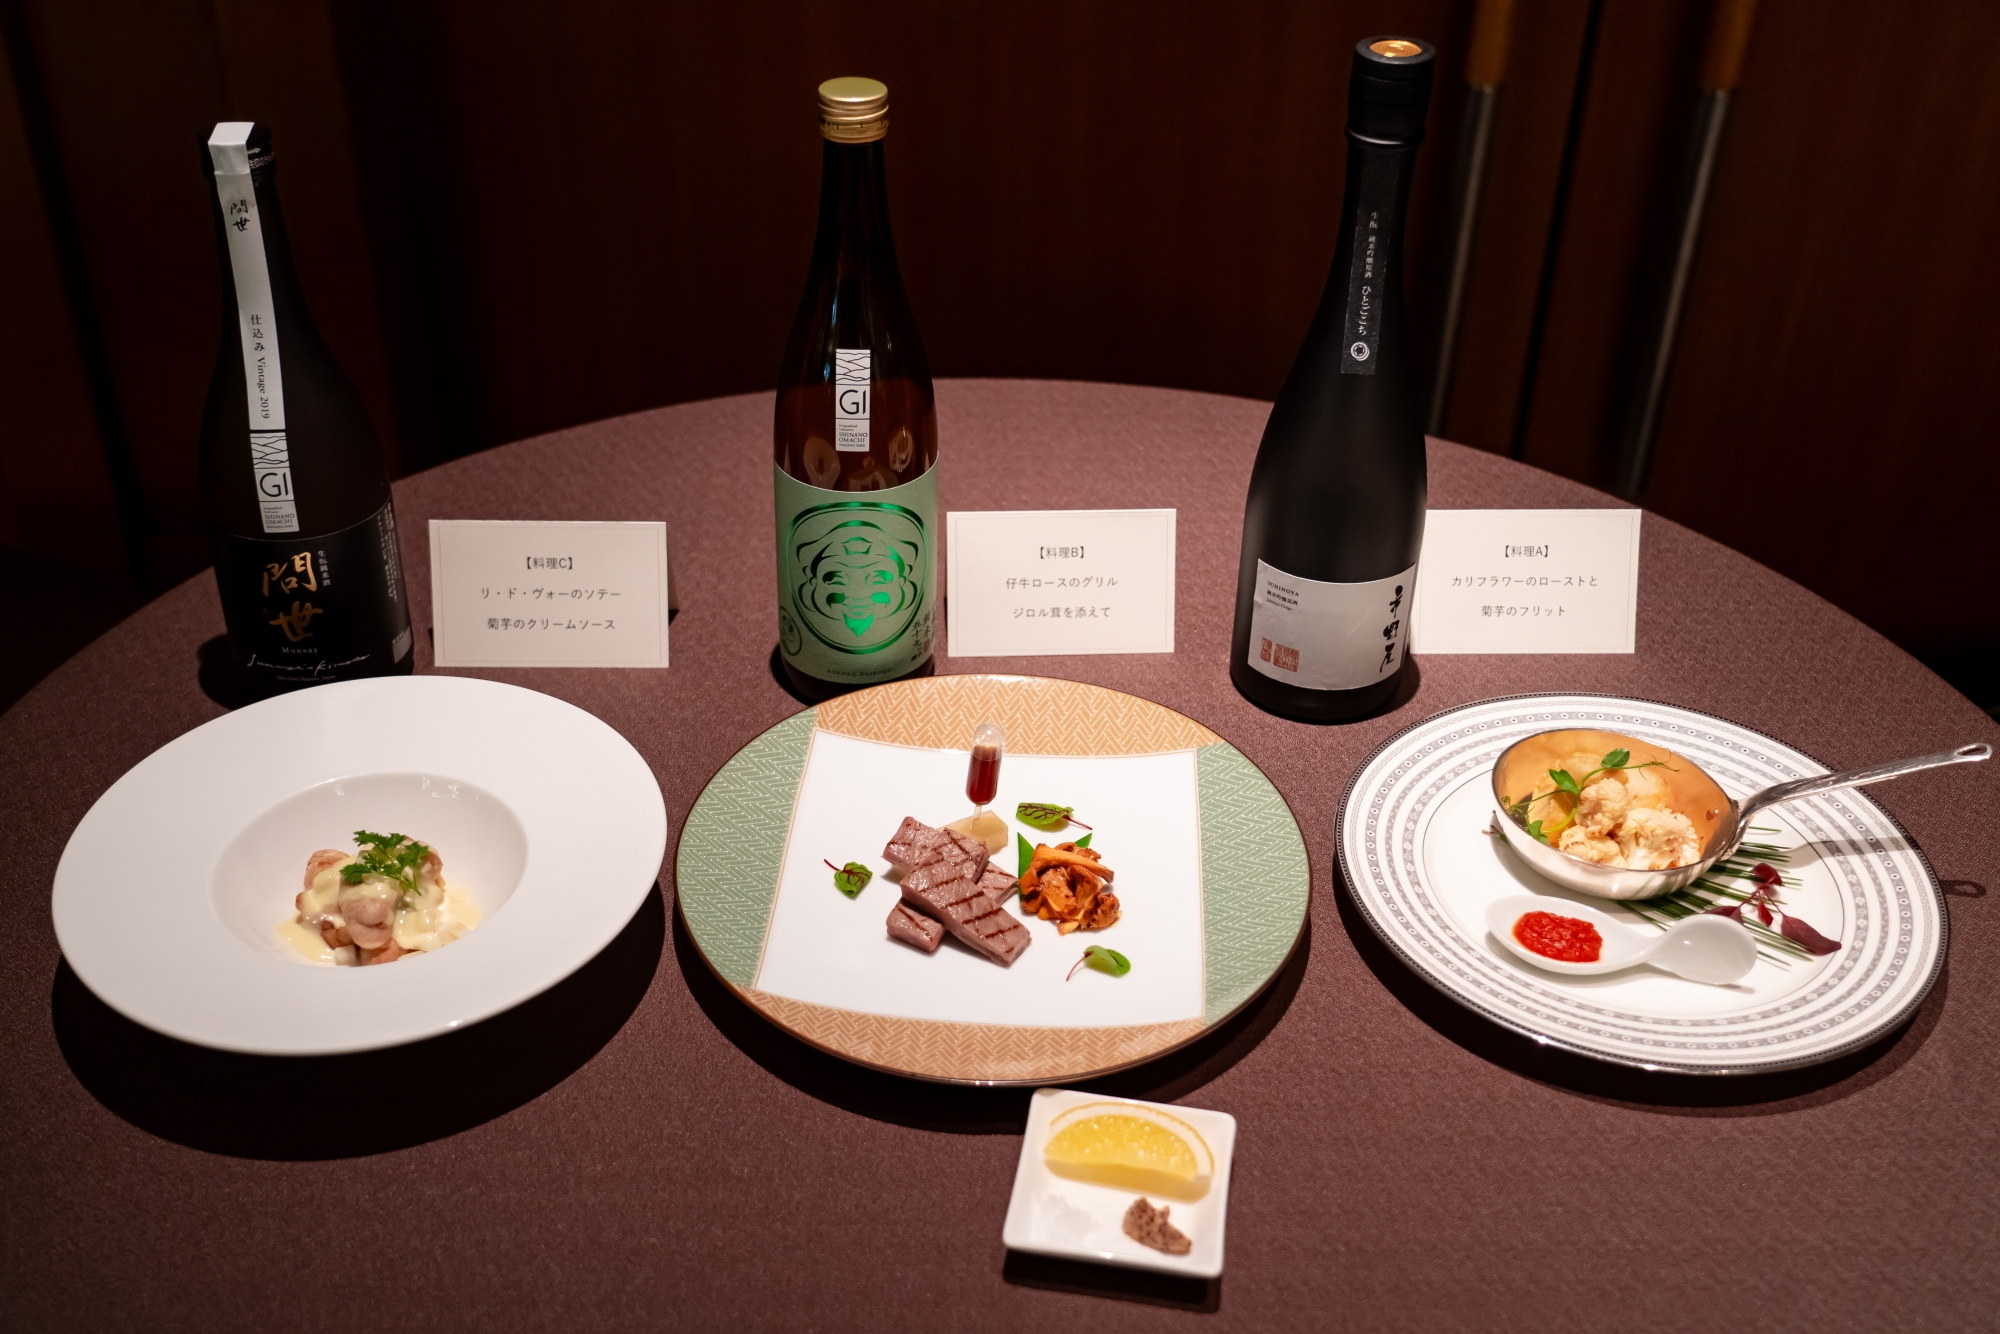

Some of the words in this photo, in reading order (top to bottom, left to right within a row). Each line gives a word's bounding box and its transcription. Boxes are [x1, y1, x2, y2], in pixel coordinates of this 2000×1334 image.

[230, 199, 250, 232] 問世
[251, 314, 265, 352] 仕込み
[257, 357, 266, 394] Vintage
[260, 396, 270, 419] 2019
[839, 389, 867, 415] GI
[259, 471, 289, 498] GI
[1040, 546, 1085, 559] 【料理B】
[1504, 545, 1549, 558] 【料理A】
[526, 556, 573, 570] 【料理C】
[1006, 576, 1118, 589] 仔牛ロースのグリル
[1451, 575, 1598, 587] カリフラワーのローストと
[481, 587, 621, 600] リ・ド・ヴォーのソテー
[1267, 580, 1299, 597] ICHINOYA
[262, 551, 323, 642] 問世
[1013, 606, 1111, 619] ジロル茸を添えて
[1480, 605, 1566, 618] 菊芋のフリット
[487, 617, 616, 630] 菊芋のクリームソース
[281, 646, 319, 654] Monsay
